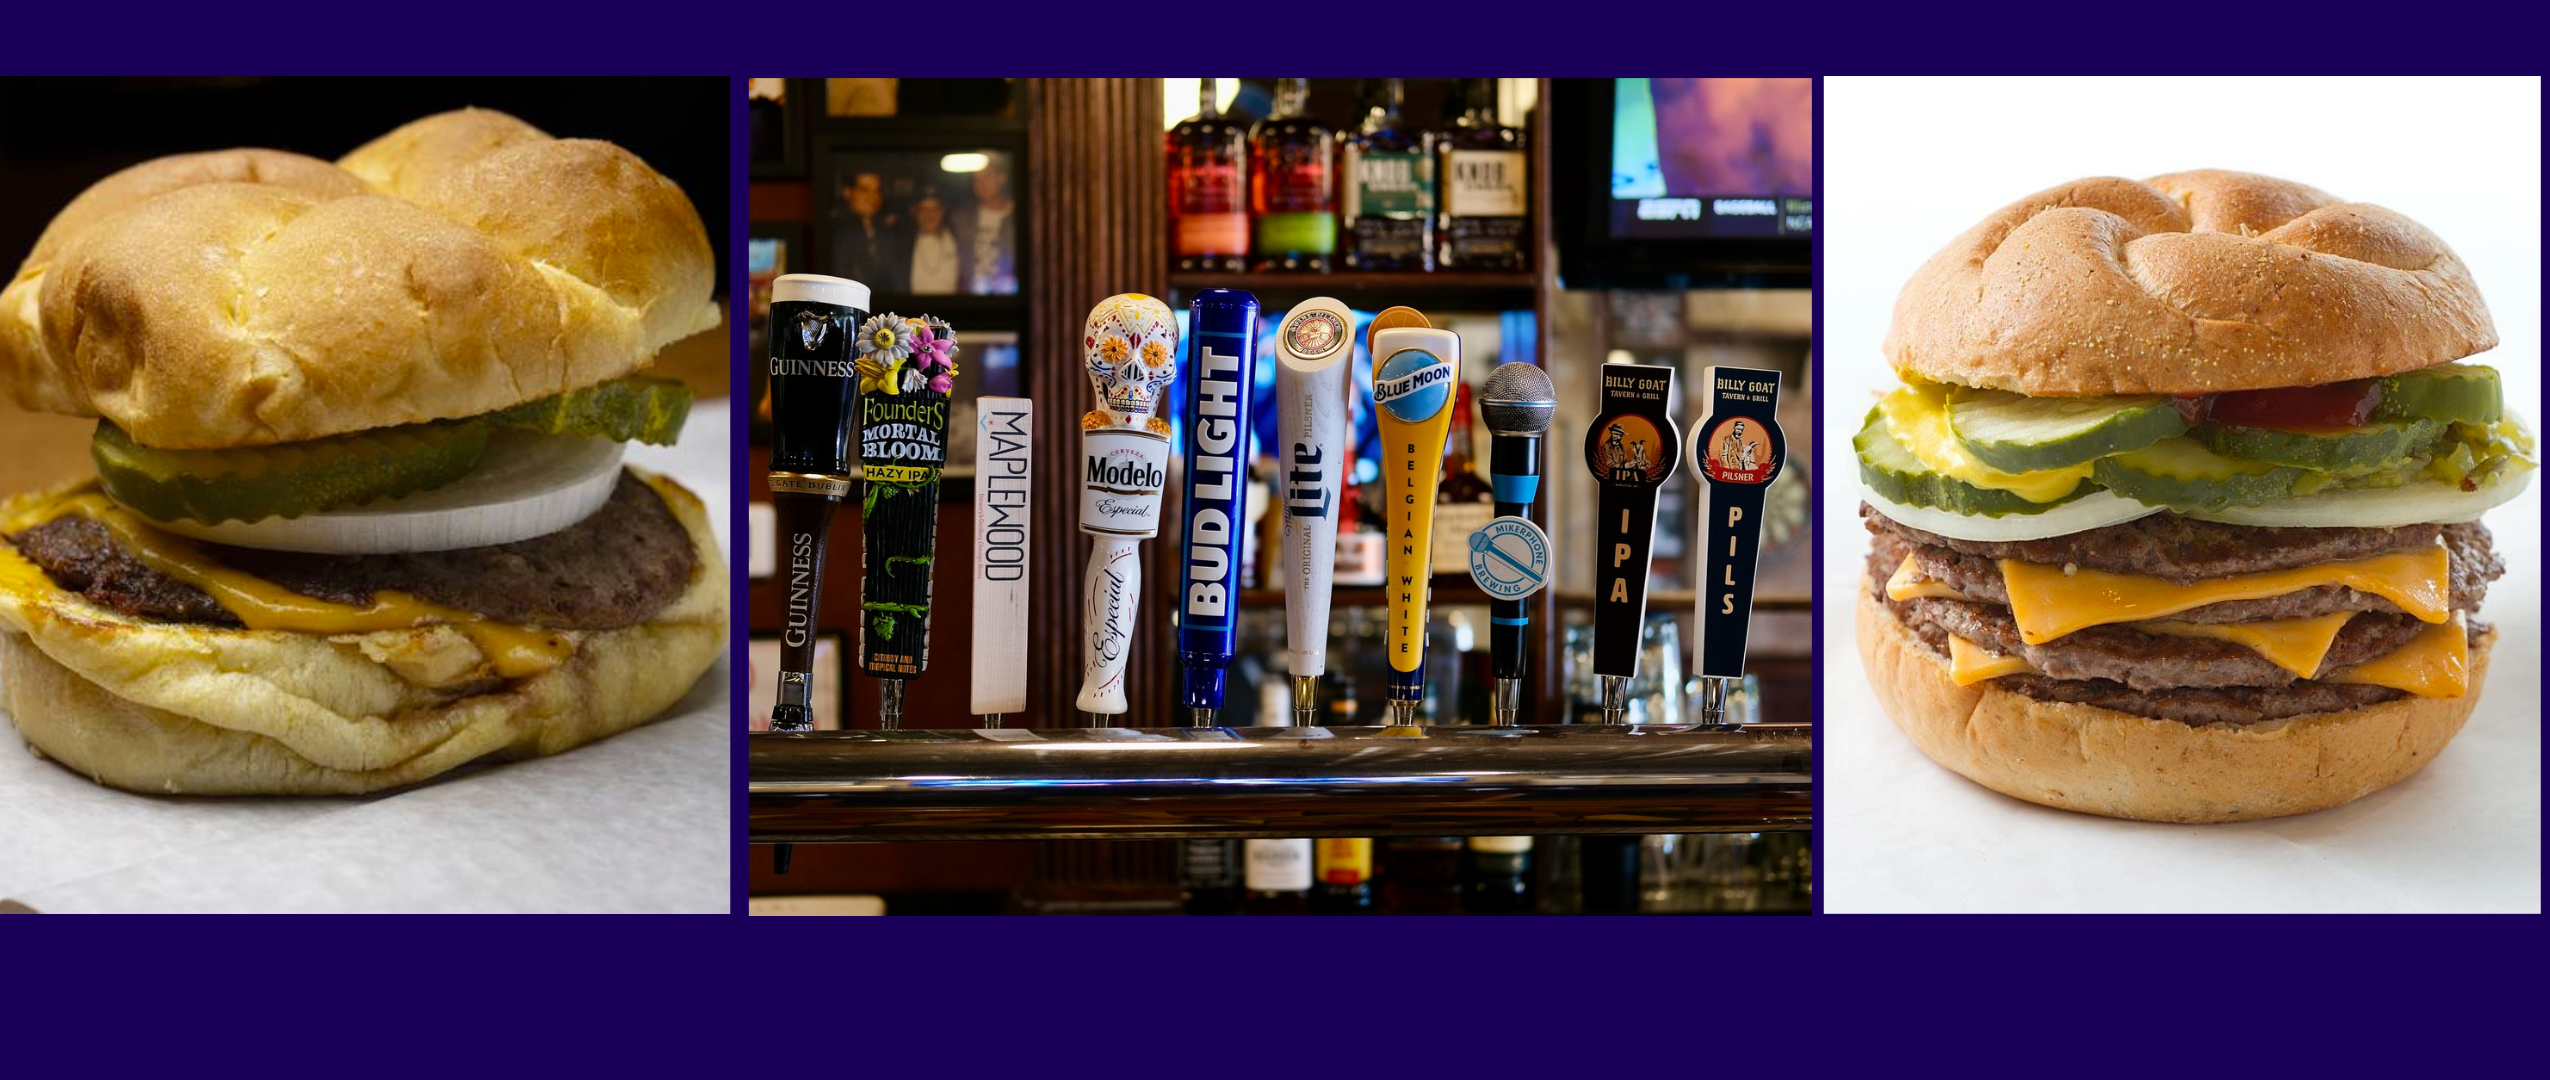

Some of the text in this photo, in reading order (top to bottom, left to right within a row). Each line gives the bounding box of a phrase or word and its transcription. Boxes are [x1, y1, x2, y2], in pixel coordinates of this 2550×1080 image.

[770, 357, 855, 378] GUINNESS
[1373, 366, 1451, 402] BLUE MOON
[1605, 375, 1667, 392] BILLY GOAT
[1610, 390, 1635, 399] TAVERN
[1642, 391, 1660, 400] GRILL
[1717, 377, 1775, 394] BILLY GOAT
[1722, 392, 1746, 401] TAVERN
[1752, 394, 1769, 403] GRILL
[1304, 393, 1313, 439] PILSNER
[863, 423, 941, 446] MORTAL
[862, 441, 942, 461] BLOOM
[1110, 448, 1144, 459] CERVEZA
[866, 468, 929, 481] HAZY IPA
[1086, 455, 1163, 488] Modelo
[1189, 346, 1239, 617] BUD LIGHT
[1289, 442, 1331, 521] Lite
[1616, 470, 1639, 482] IPA
[1722, 471, 1754, 482] PILSNER
[776, 480, 802, 488] GATE
[808, 481, 846, 491] DUBLIN
[985, 411, 1029, 581] MAPLEWOOD
[1095, 499, 1150, 518] Especial
[1404, 444, 1415, 555] BELGIAN
[1303, 525, 1311, 575] ORIGINAL
[1495, 524, 1543, 565] MIKERPHONE
[1610, 508, 1631, 603] IPA
[1722, 506, 1743, 615] PILS
[785, 533, 812, 648] GUINNESS
[1475, 564, 1521, 593] BREWING
[1093, 568, 1125, 668] Especial
[1401, 576, 1413, 653] WHITE
[868, 662, 917, 674] TROPICAL NOTES
[873, 653, 913, 664] CITRUSY AND
